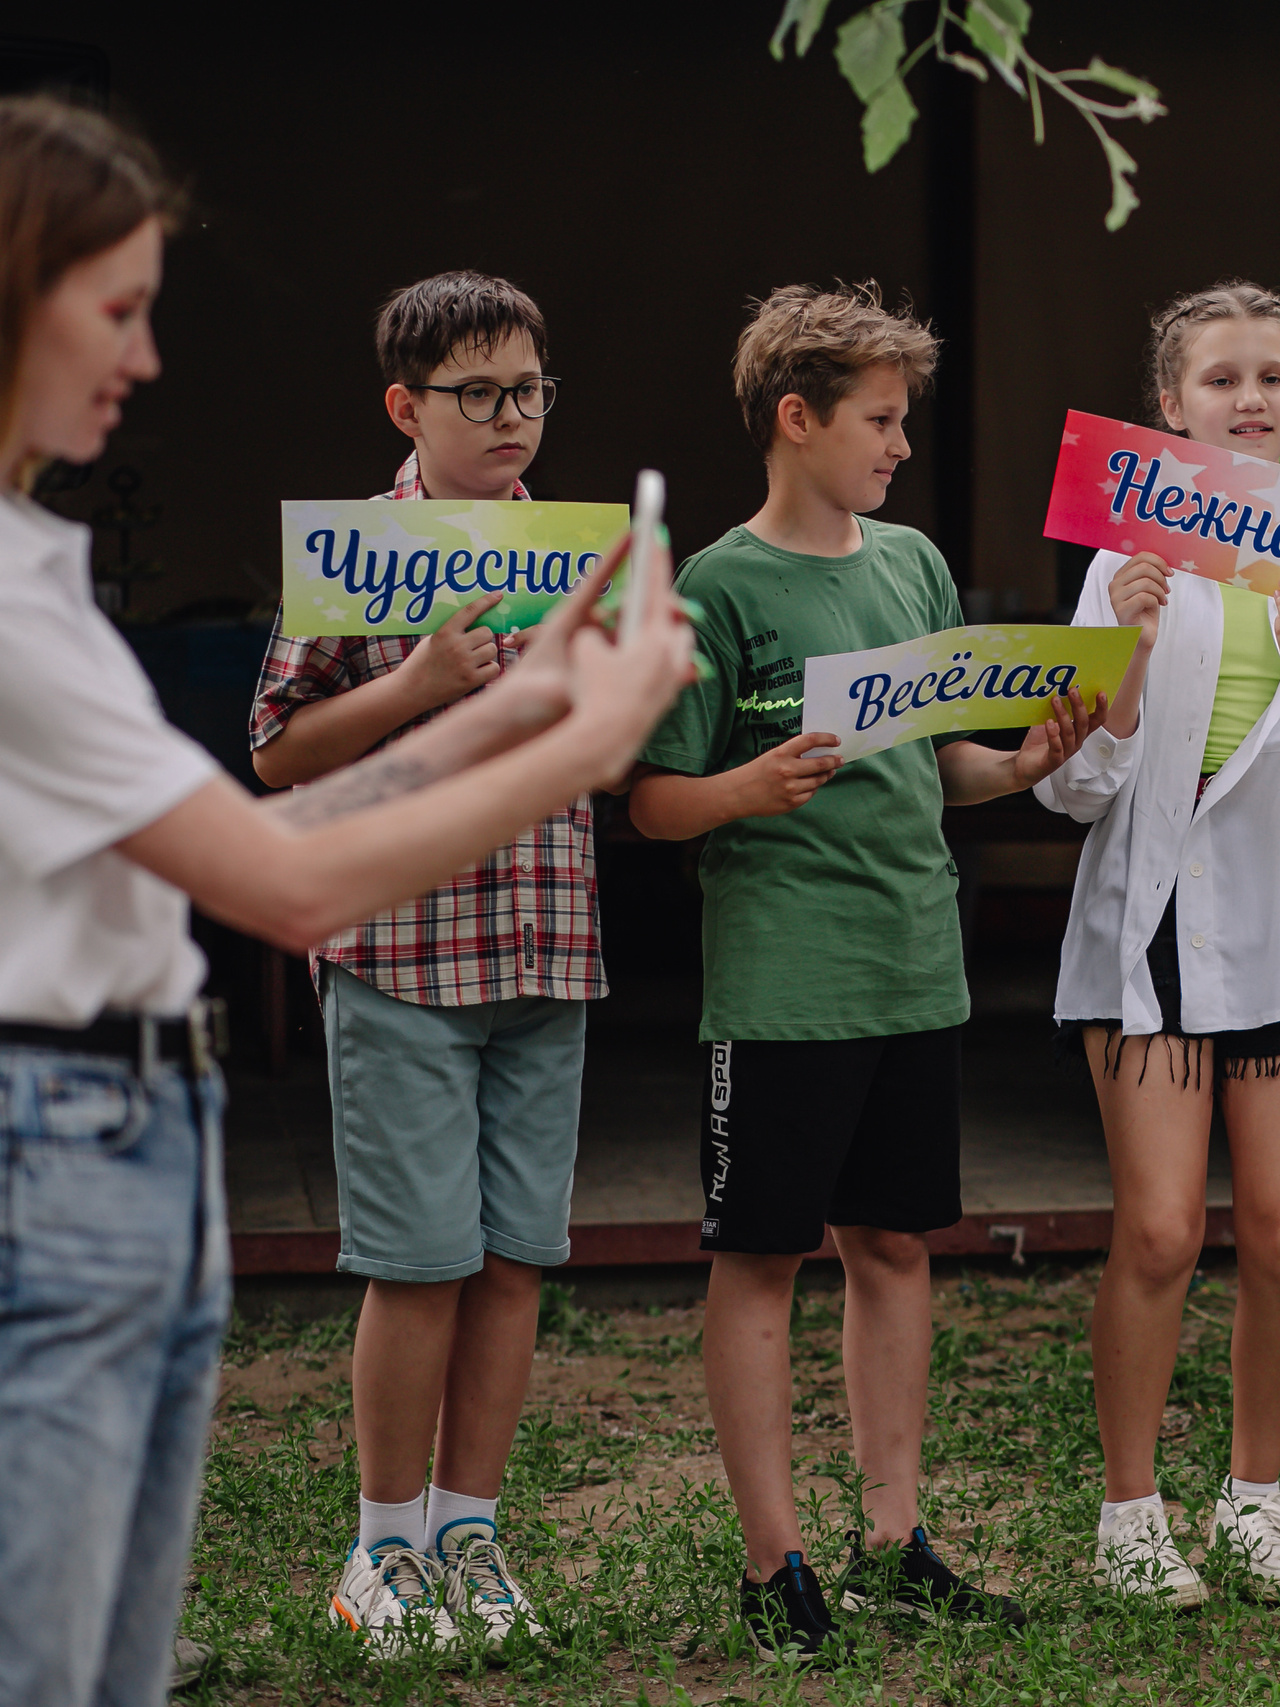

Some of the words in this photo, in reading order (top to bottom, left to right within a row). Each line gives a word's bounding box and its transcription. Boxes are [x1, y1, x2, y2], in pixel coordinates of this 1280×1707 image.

[766, 629, 779, 642] TO
[756, 656, 795, 678] MINUTES
[767, 669, 803, 691] DECIDED
[848, 650, 1080, 732] Весёлая
[782, 714, 803, 731] SOM
[714, 1040, 728, 1102] SPO
